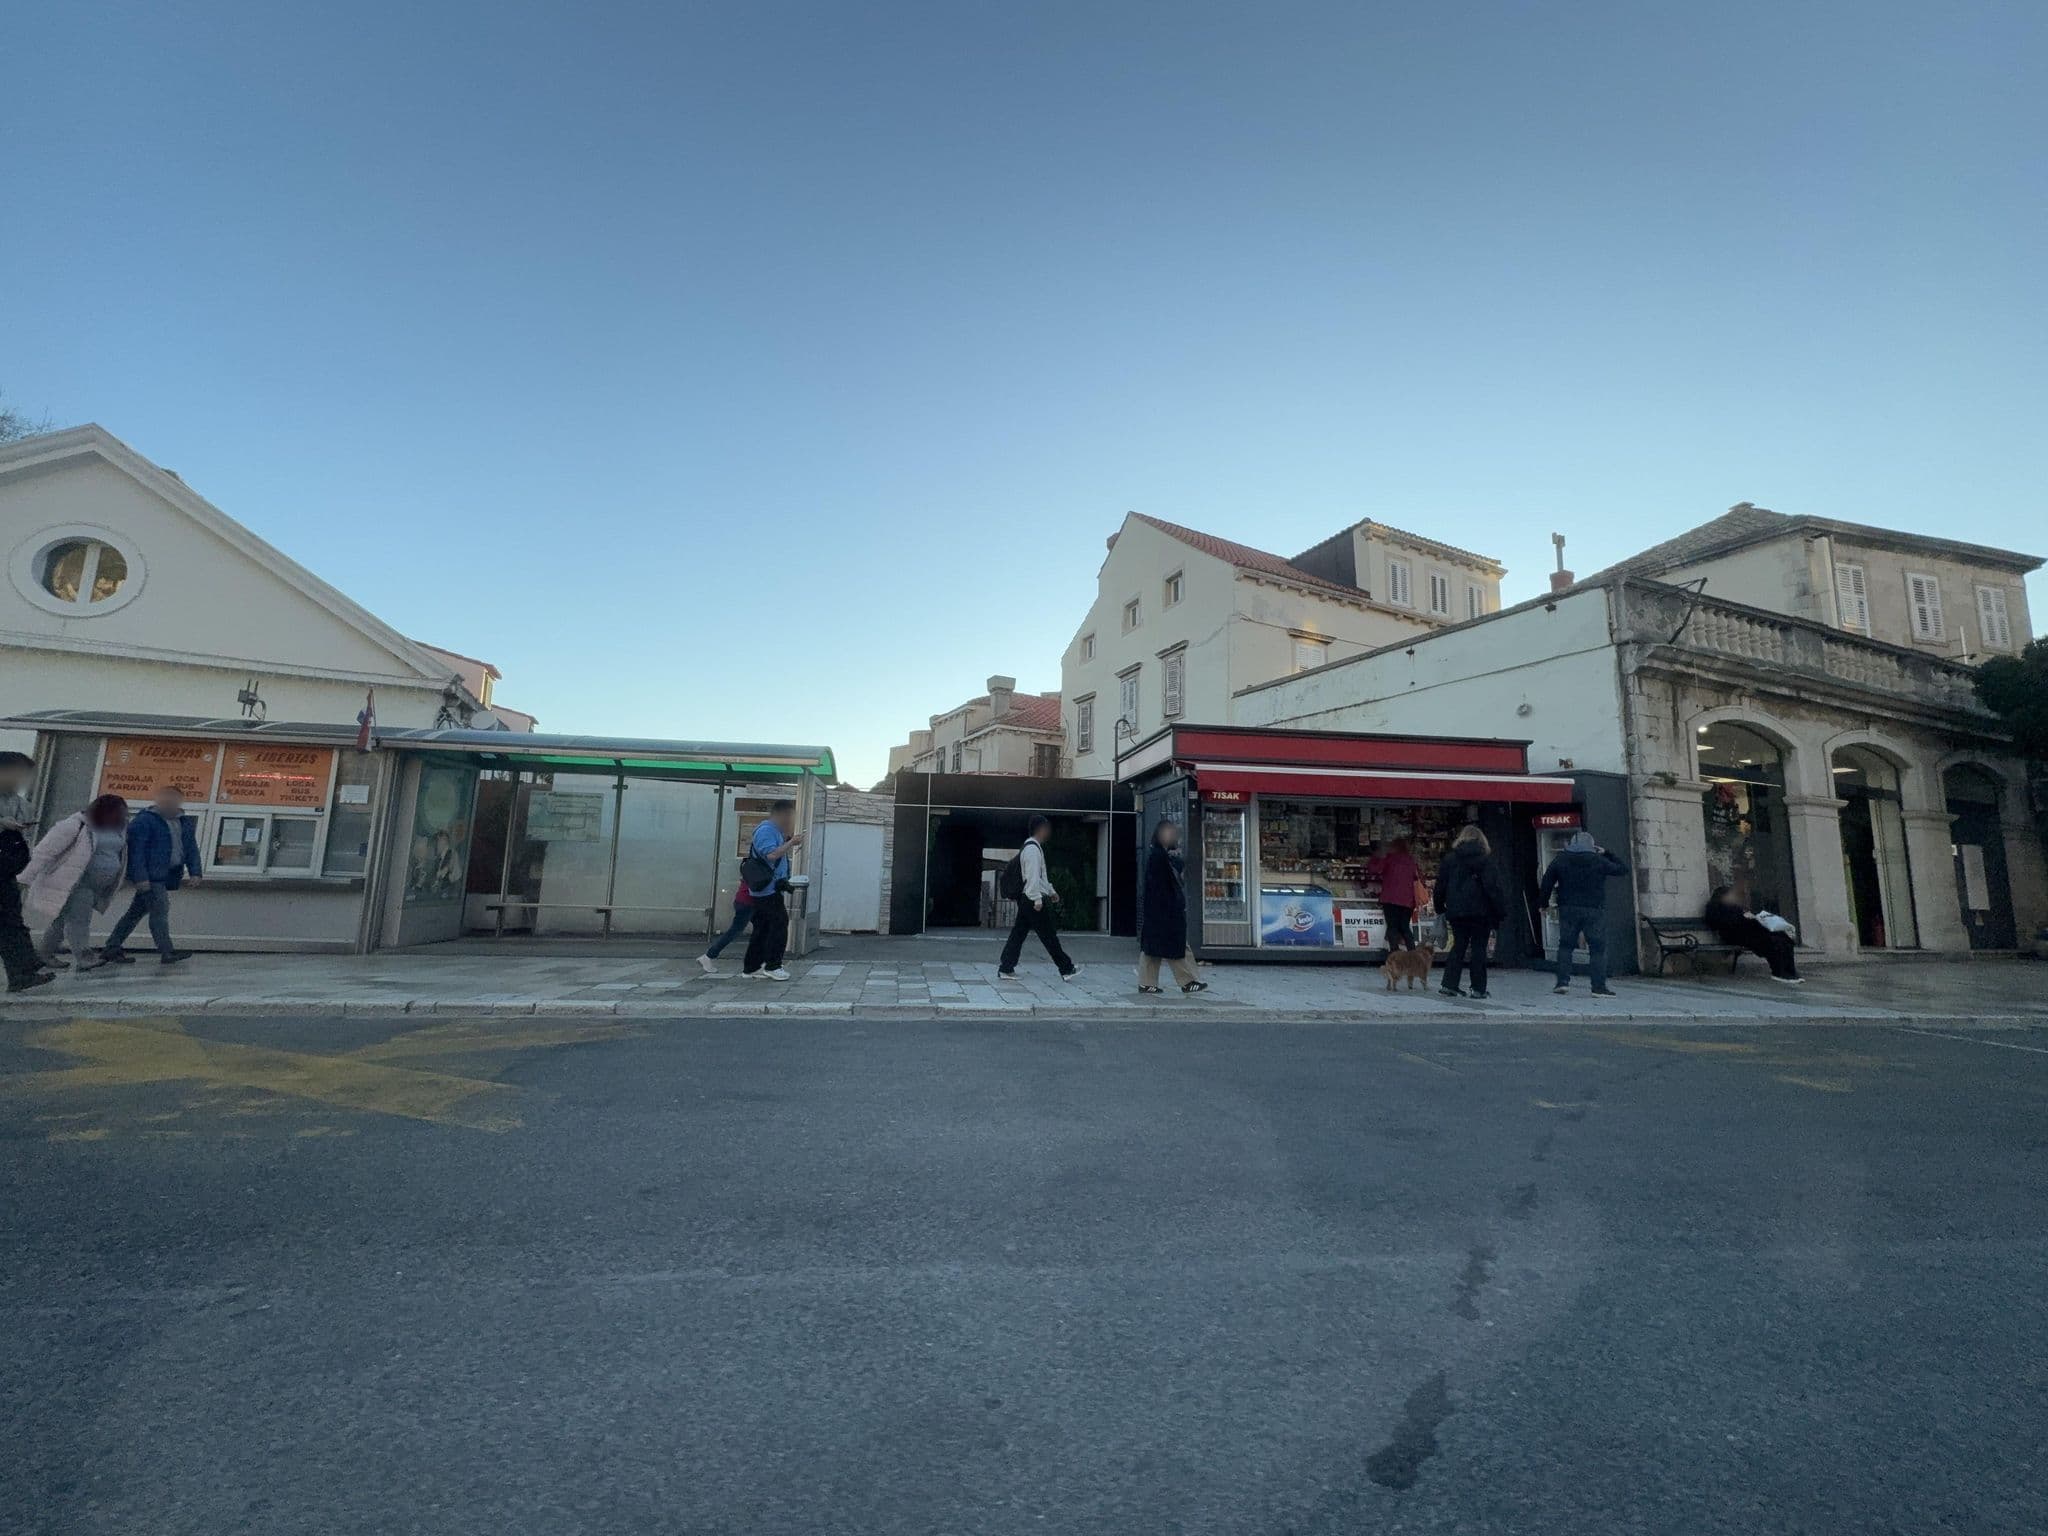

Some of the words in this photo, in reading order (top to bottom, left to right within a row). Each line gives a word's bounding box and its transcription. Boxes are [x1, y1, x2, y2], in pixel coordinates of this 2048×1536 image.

[138, 745, 204, 760] LIBERTAS
[256, 751, 319, 765] LIBERTAS
[107, 774, 154, 783] PRODAJA
[169, 775, 201, 783] LOCAL
[108, 783, 150, 792] KARATA
[225, 780, 271, 788] PRODAJA
[286, 780, 317, 788] LOCAL
[280, 794, 319, 802] TICKETS
[1212, 791, 1240, 800] TISAK
[1541, 816, 1570, 824] TISAK
